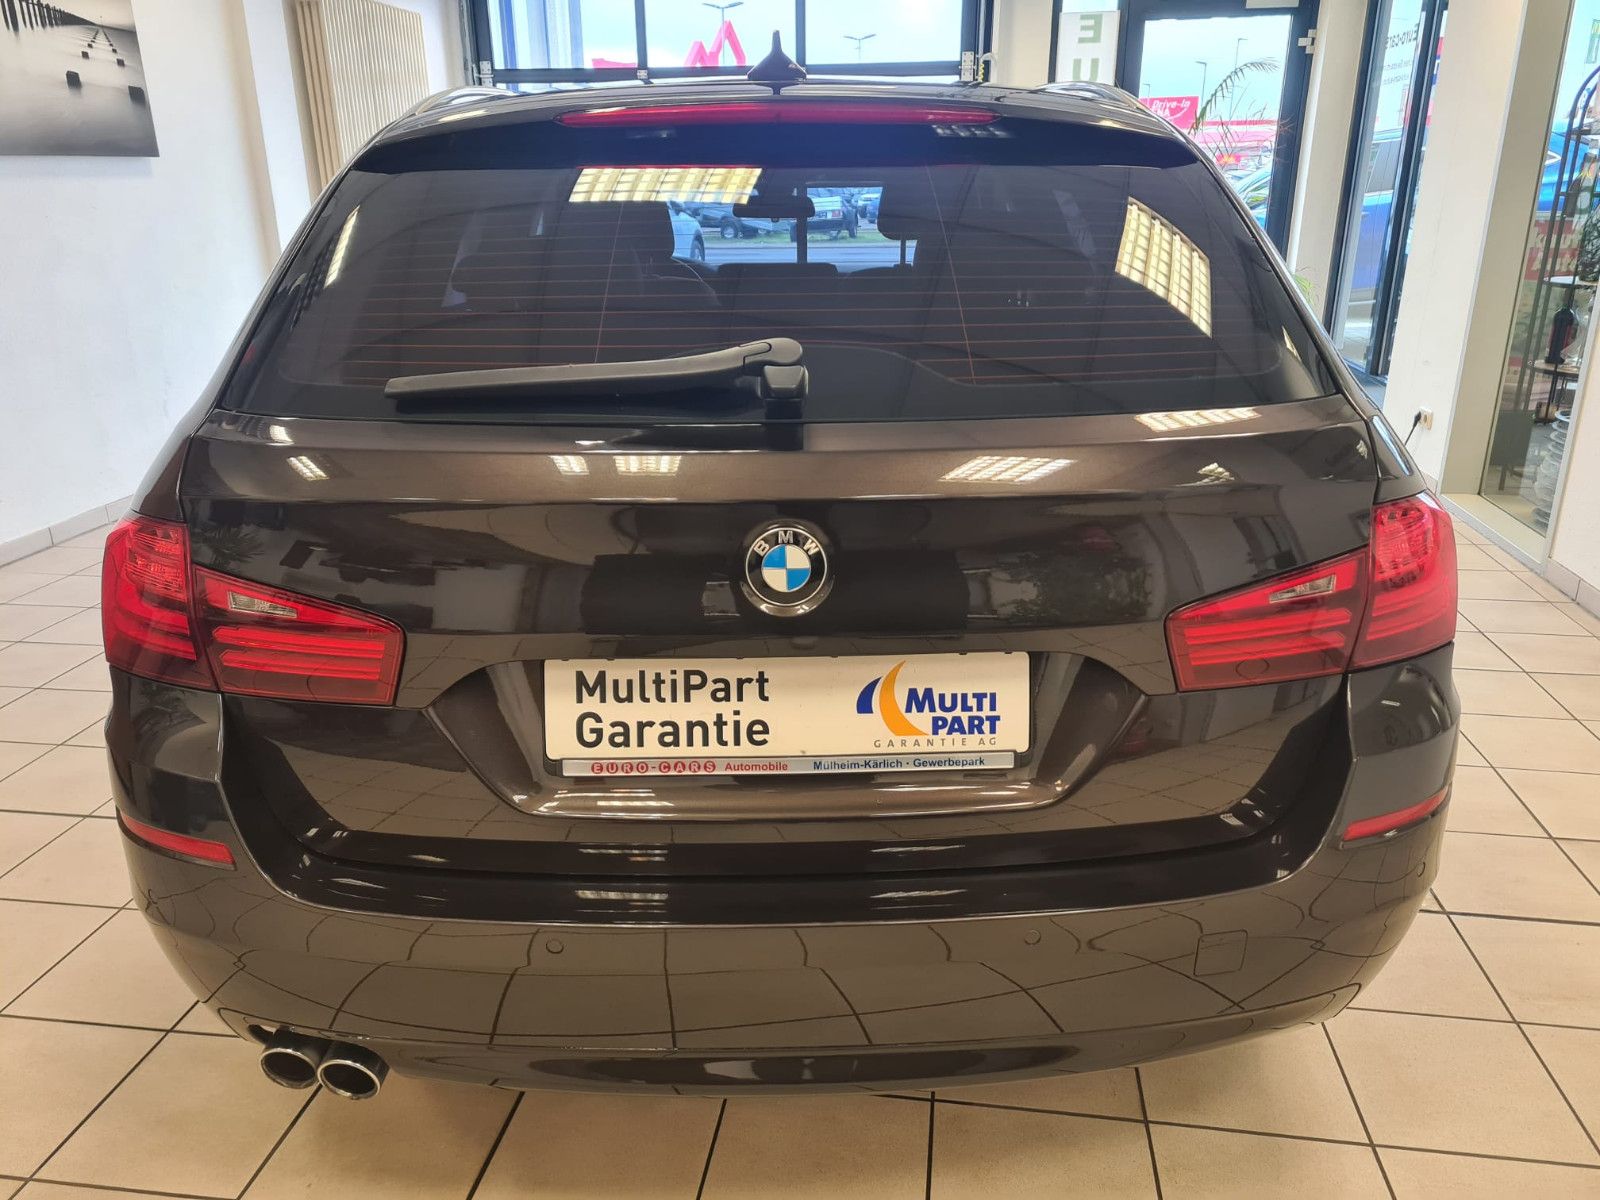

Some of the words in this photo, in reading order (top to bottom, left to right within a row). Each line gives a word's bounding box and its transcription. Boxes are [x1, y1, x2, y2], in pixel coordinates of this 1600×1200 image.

[753, 530, 820, 557] BMW
[575, 669, 770, 704] MultiPart
[904, 687, 997, 713] MULTI
[575, 709, 770, 749] Garantie
[931, 715, 1001, 736] PART
[873, 737, 967, 748] GARANTIE
[978, 737, 997, 746] AG
[591, 760, 716, 774] EURO-CARS
[724, 761, 788, 772] Automobile
[813, 758, 903, 771] Mülheim-Kärlich
[913, 757, 985, 768] Gewerbepark
